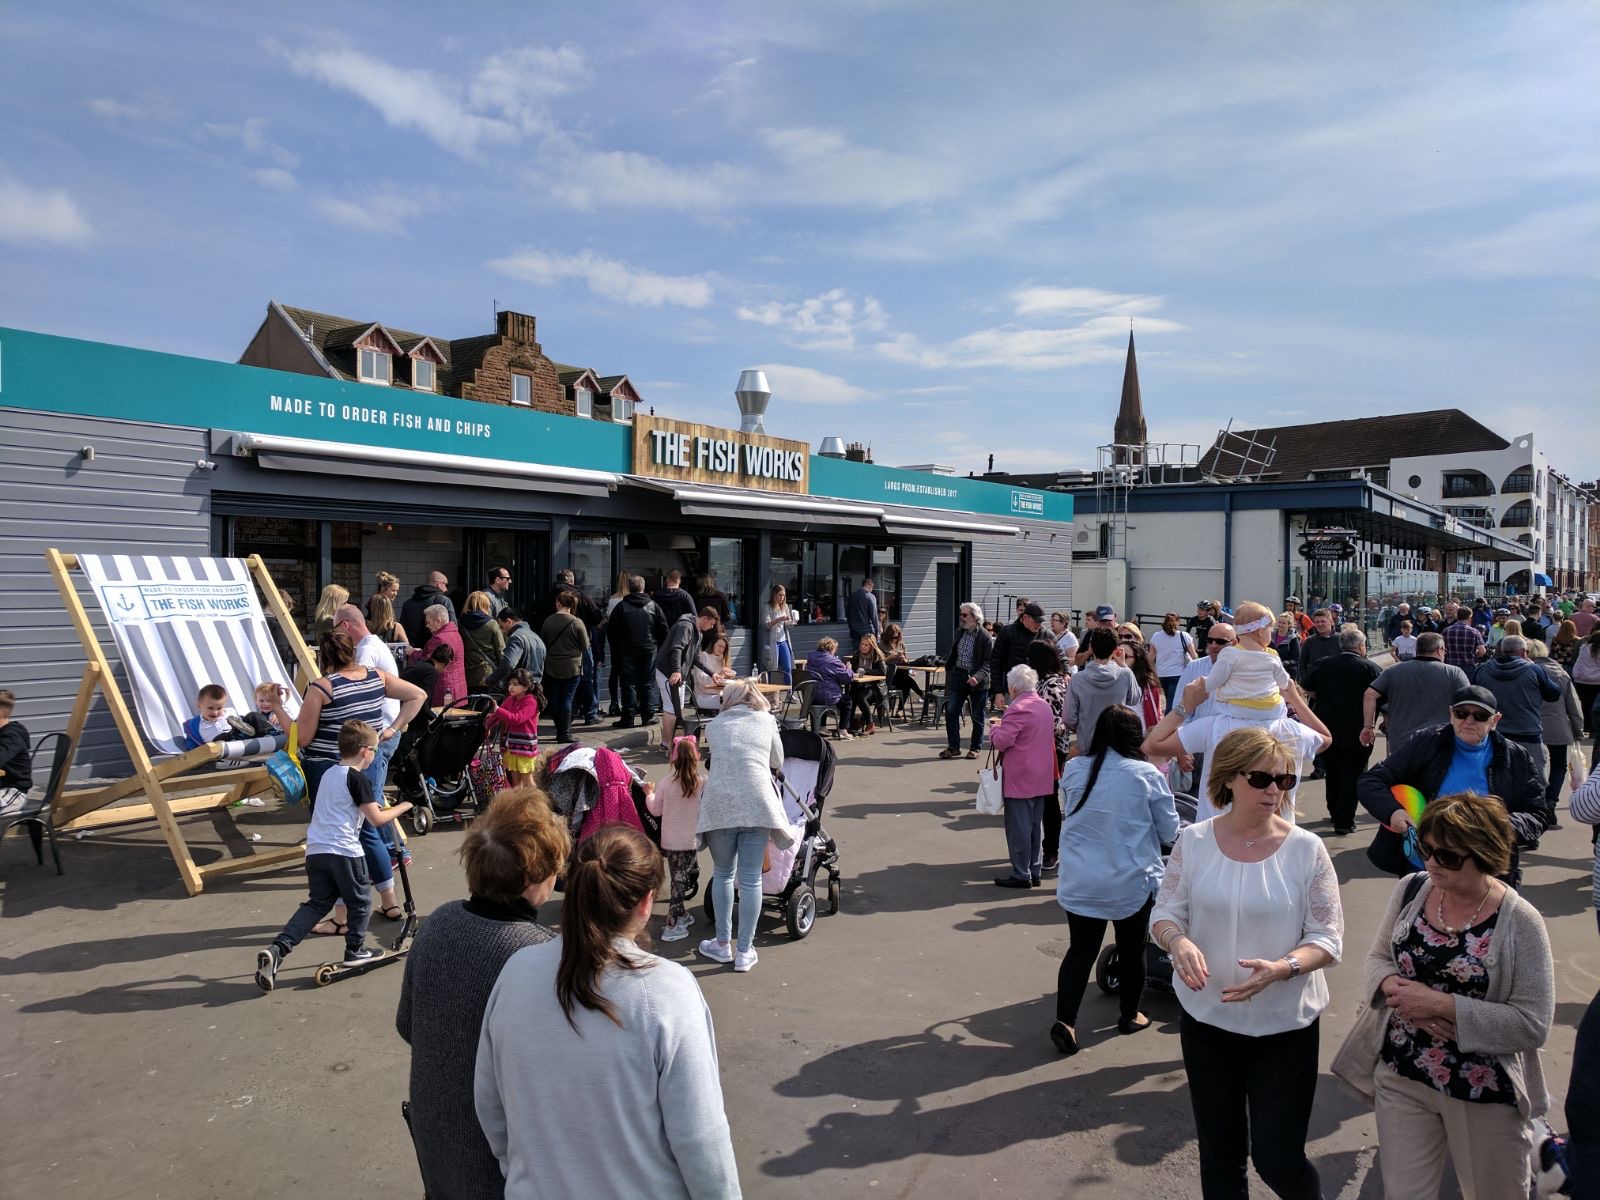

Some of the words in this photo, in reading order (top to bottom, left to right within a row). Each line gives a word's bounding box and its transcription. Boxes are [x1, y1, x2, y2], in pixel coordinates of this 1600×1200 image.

[270, 395, 312, 415] MADE
[319, 402, 335, 418] TO
[342, 405, 387, 425] ORDER
[393, 412, 422, 429] FISH
[427, 417, 451, 432] AND
[456, 421, 491, 438] CHIPS
[652, 430, 690, 467] THE
[697, 436, 738, 473] FISH
[745, 444, 804, 482] WORKS
[884, 480, 900, 491] LARGS
[947, 489, 958, 498] 2017
[150, 599, 176, 610] THE
[180, 598, 205, 610] FISH
[207, 597, 250, 610] WORKS
